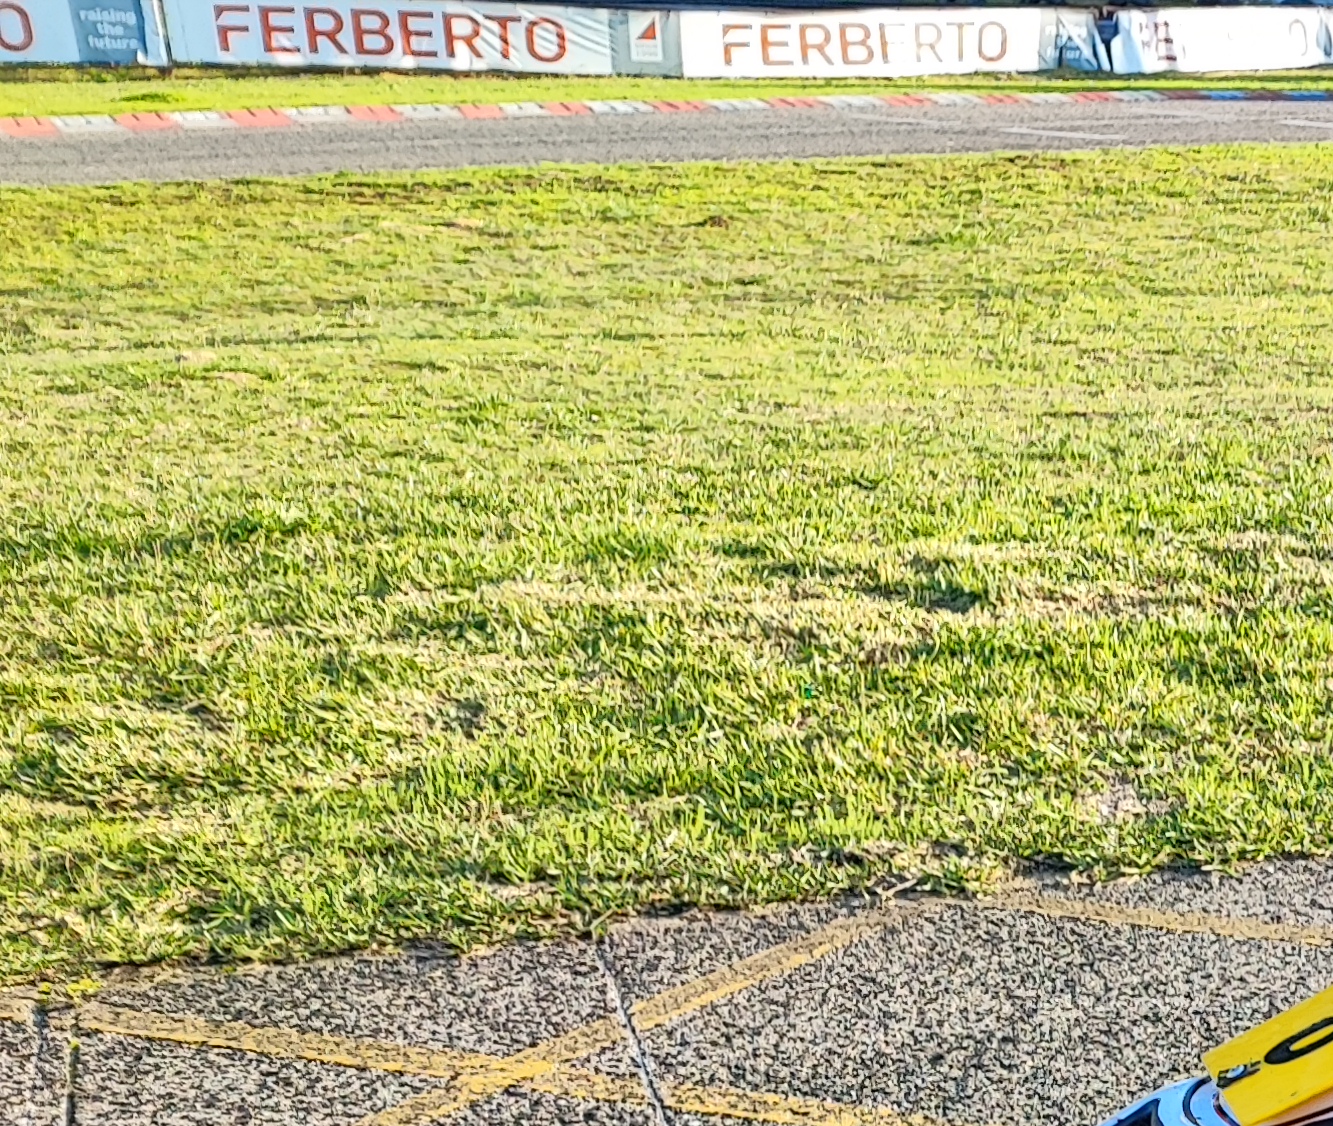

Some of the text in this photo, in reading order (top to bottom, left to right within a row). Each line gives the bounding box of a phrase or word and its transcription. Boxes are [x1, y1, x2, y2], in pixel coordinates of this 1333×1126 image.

[79, 8, 137, 25] raising
[96, 22, 125, 36] the
[213, 4, 567, 63] FERBERTO
[87, 34, 139, 50] future
[722, 21, 1008, 66] FERBERTO
